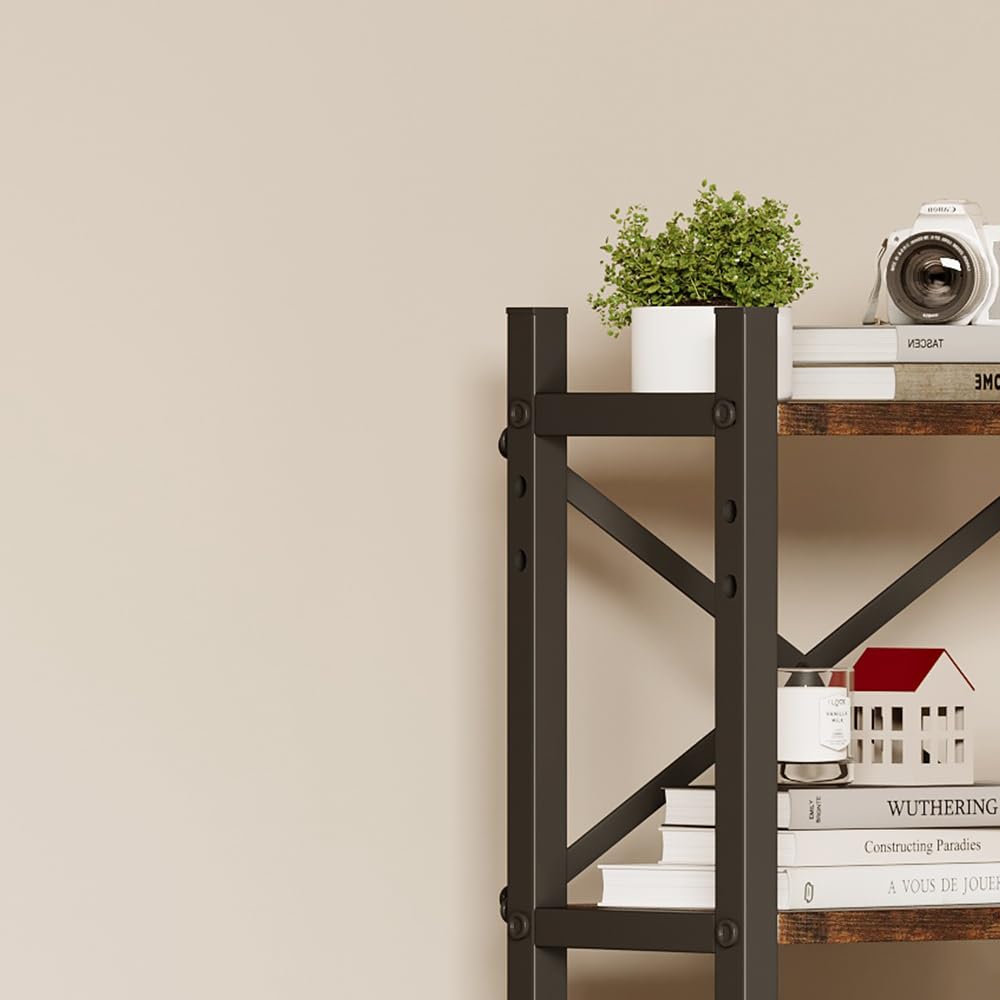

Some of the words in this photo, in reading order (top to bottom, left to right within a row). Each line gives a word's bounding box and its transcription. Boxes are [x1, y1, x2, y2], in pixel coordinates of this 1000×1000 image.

[888, 799, 998, 816] WUTHERING
[864, 839, 933, 855] Constructing
[936, 838, 982, 852] Paradies
[888, 881, 896, 894] A
[902, 879, 935, 893] VOUS
[941, 877, 958, 893] DE
